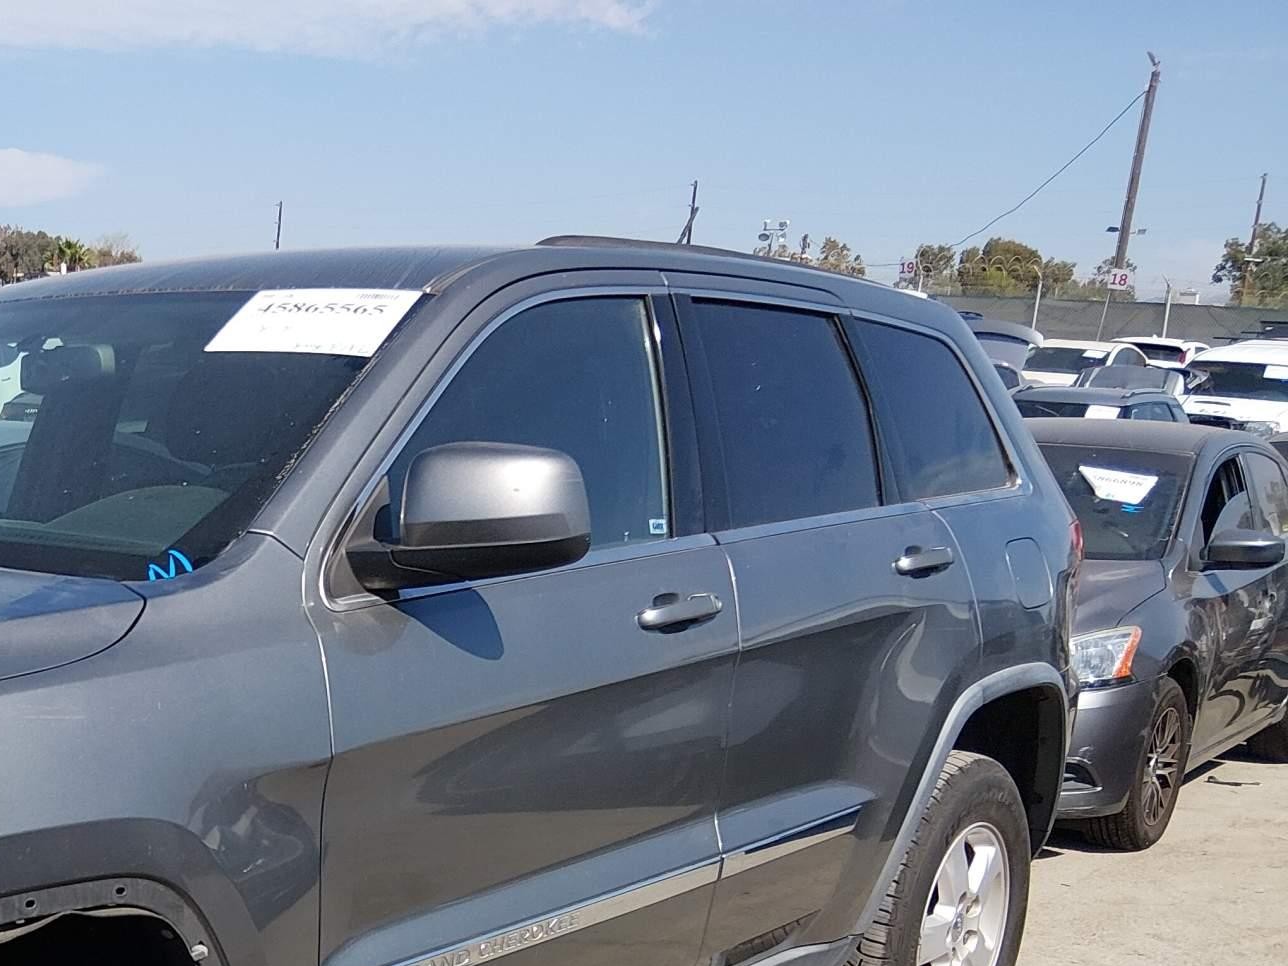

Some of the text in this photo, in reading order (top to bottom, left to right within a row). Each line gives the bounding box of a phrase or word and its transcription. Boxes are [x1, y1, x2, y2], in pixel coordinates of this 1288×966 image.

[898, 261, 915, 274] 19
[1109, 273, 1128, 287] 18
[258, 302, 388, 316] 45865565
[479, 913, 581, 959] CHEROKEE
